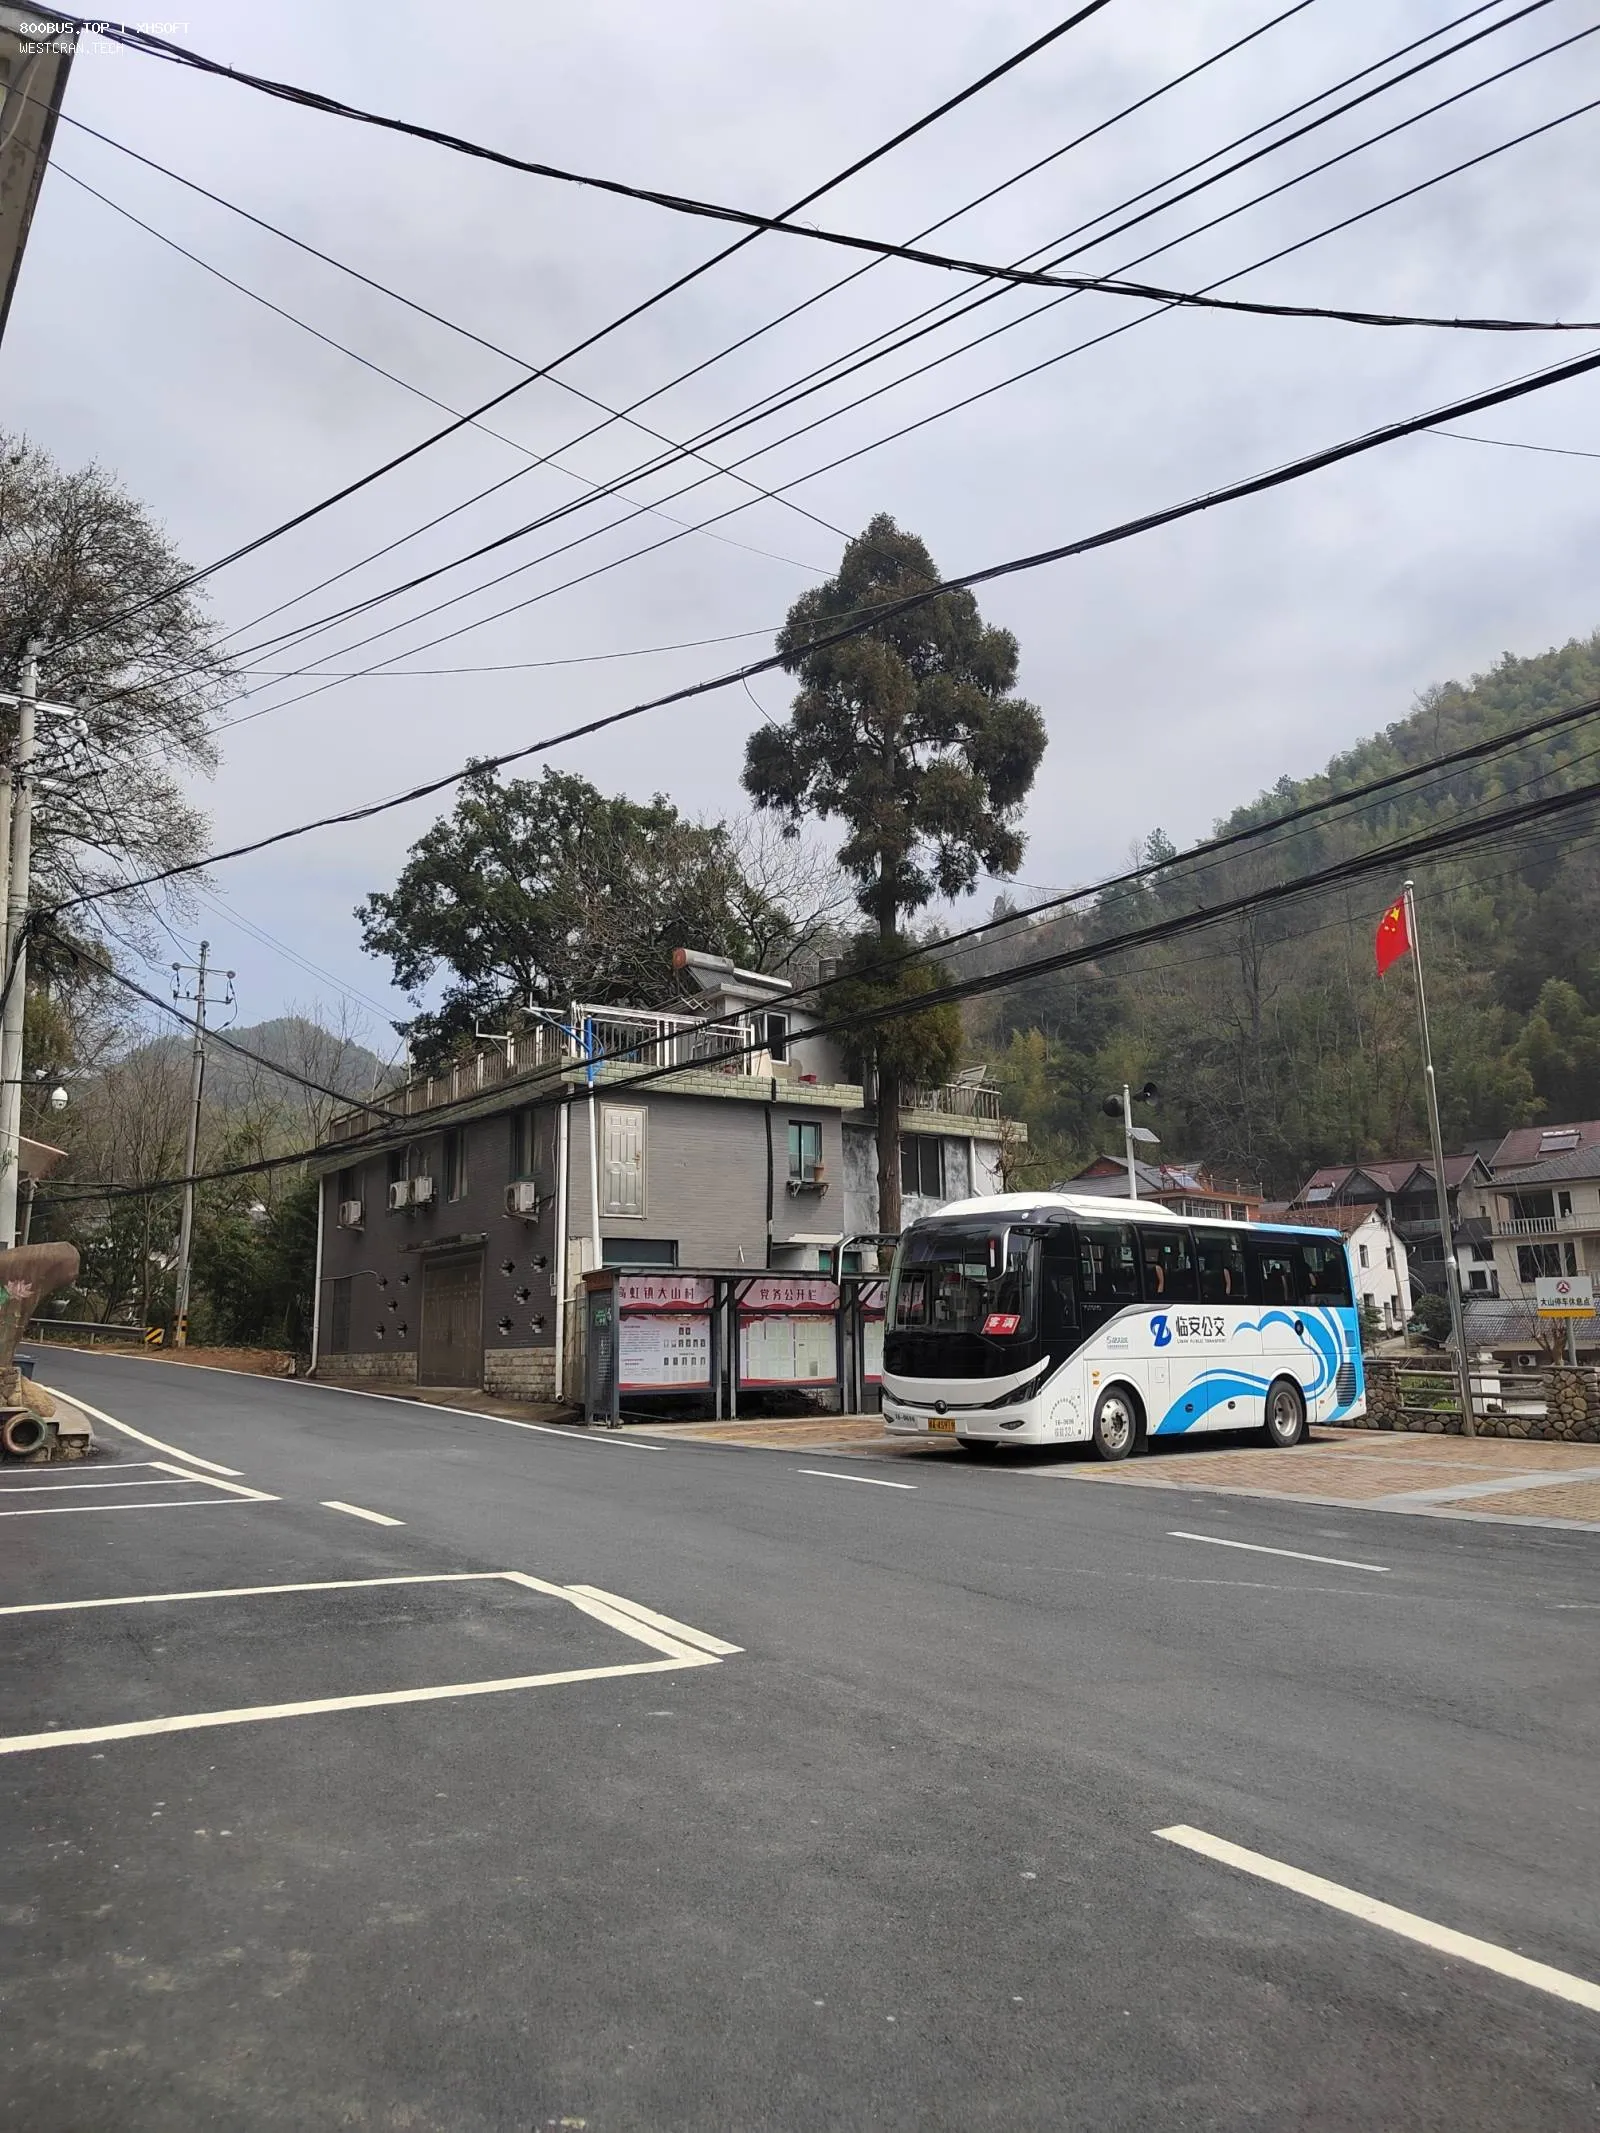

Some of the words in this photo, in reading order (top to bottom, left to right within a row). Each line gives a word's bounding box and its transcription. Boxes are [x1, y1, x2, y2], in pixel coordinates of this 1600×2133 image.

[619, 1286, 695, 1300] 高虹镇大山村
[760, 1288, 817, 1301] 党务公开栏
[1540, 1297, 1591, 1307] 大山停车休息点
[1176, 1315, 1226, 1337] 临安公交
